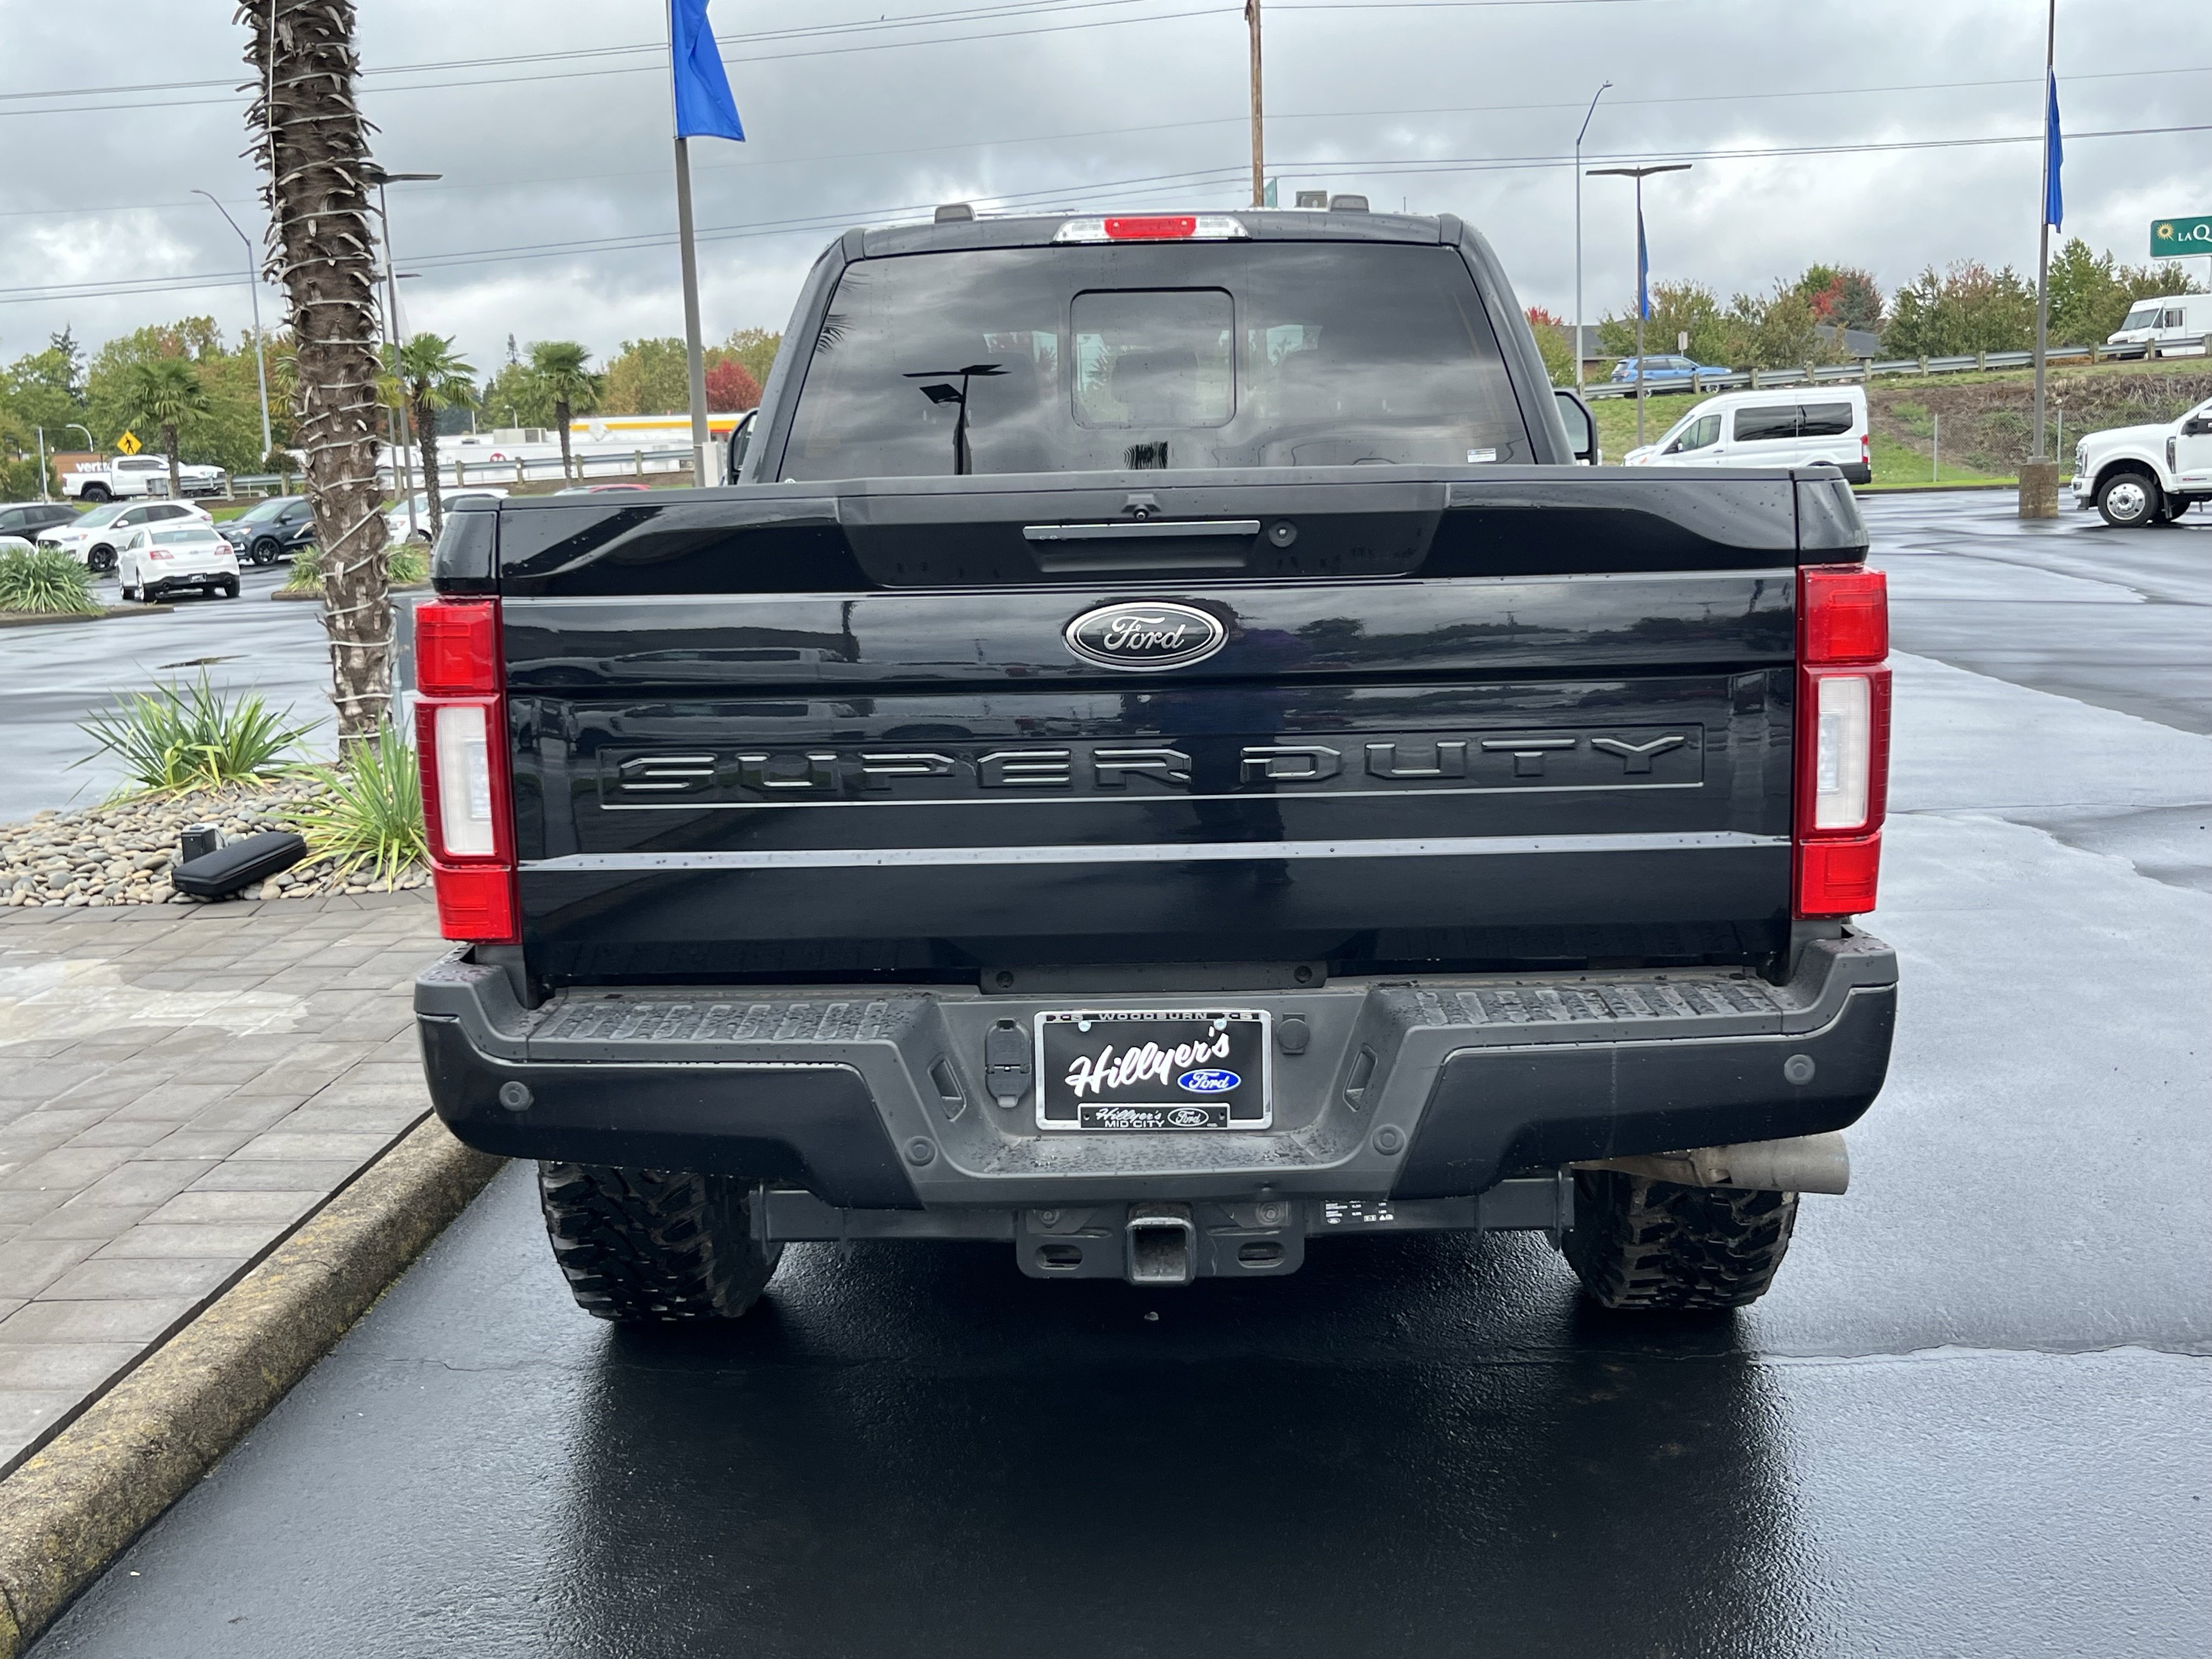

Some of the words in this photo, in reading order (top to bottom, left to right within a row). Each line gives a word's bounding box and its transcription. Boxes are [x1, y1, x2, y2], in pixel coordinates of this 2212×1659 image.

[2178, 232, 2192, 241] LA
[1104, 616, 1186, 651] Ford
[618, 747, 1193, 795] SUPER
[1239, 735, 1686, 785] DUTY
[1098, 1012, 1208, 1020] WOODBURN
[1064, 1026, 1230, 1097] Hillyer's
[1188, 1071, 1230, 1090] Ford
[1096, 1107, 1163, 1123] Hillyer's
[1175, 1110, 1201, 1124] Ford
[1132, 1120, 1165, 1128] CITY
